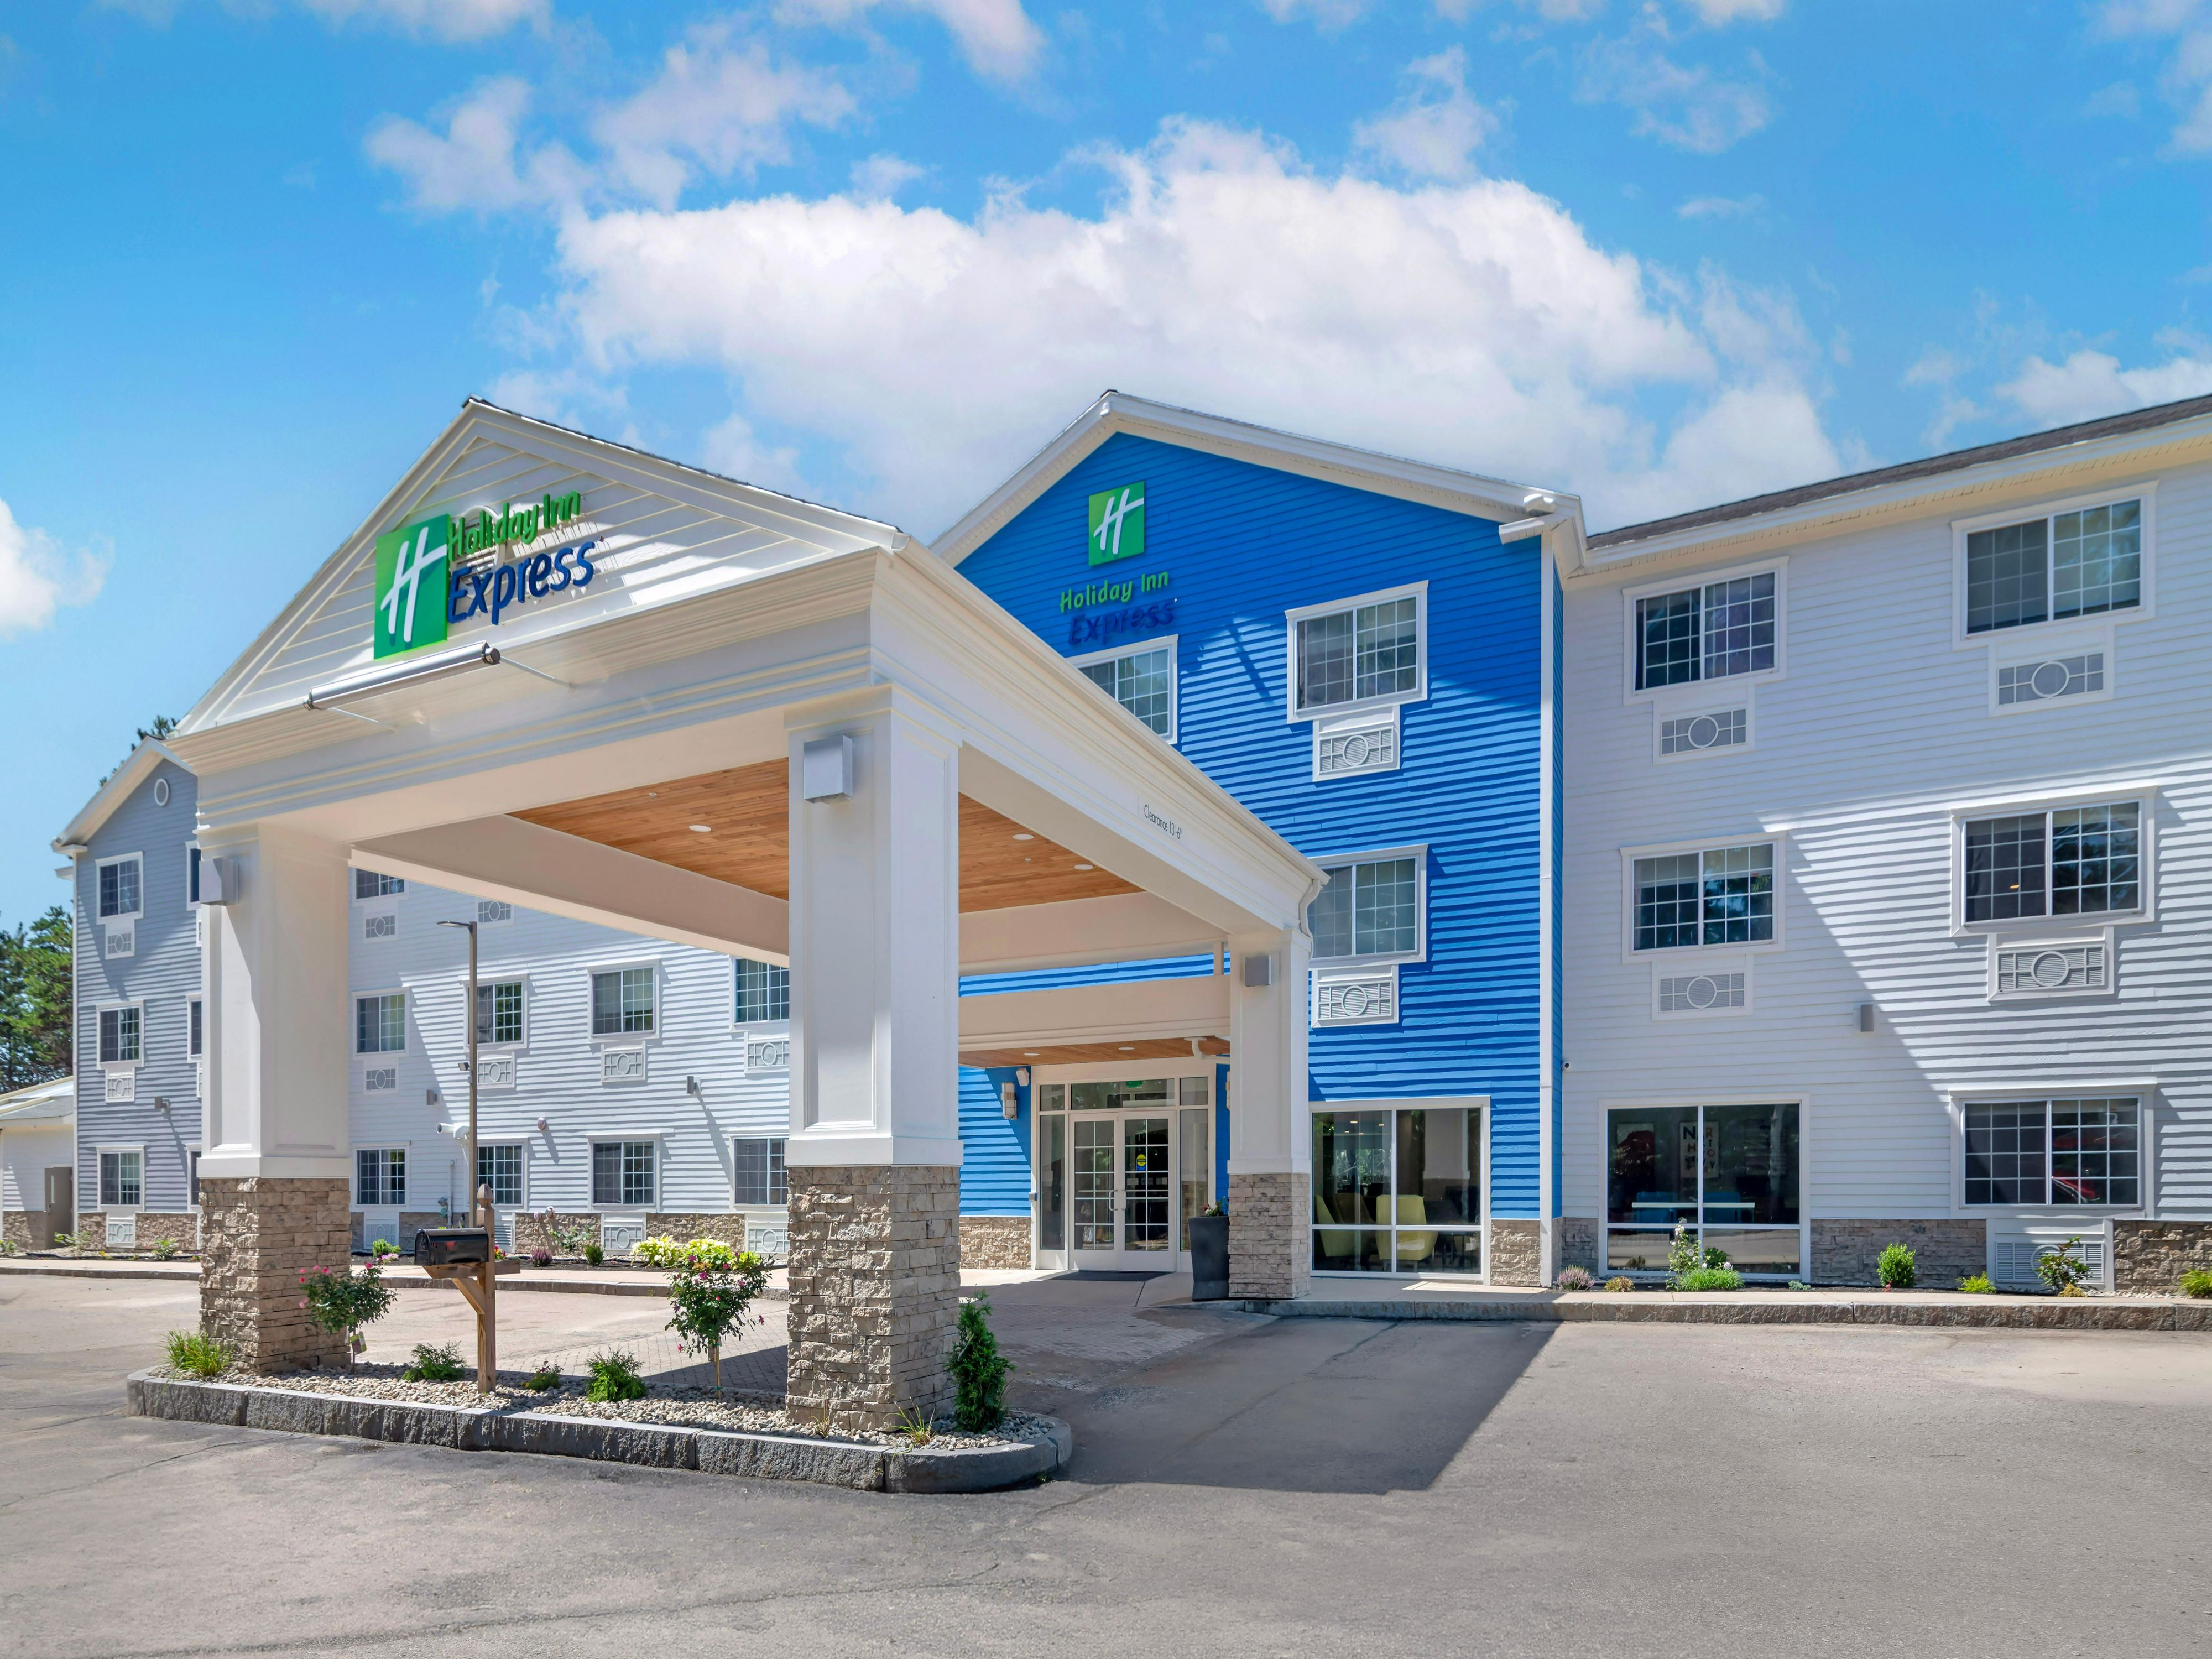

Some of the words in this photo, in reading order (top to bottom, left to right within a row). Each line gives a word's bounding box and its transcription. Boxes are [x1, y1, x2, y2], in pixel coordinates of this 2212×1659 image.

[447, 502, 540, 562] Holiday
[543, 490, 581, 529] Inn
[447, 541, 596, 625] Express
[1059, 579, 1133, 613] Holiday
[1141, 571, 1168, 593] Inn
[1068, 600, 1175, 645] Express
[1144, 804, 1168, 832] Clearance
